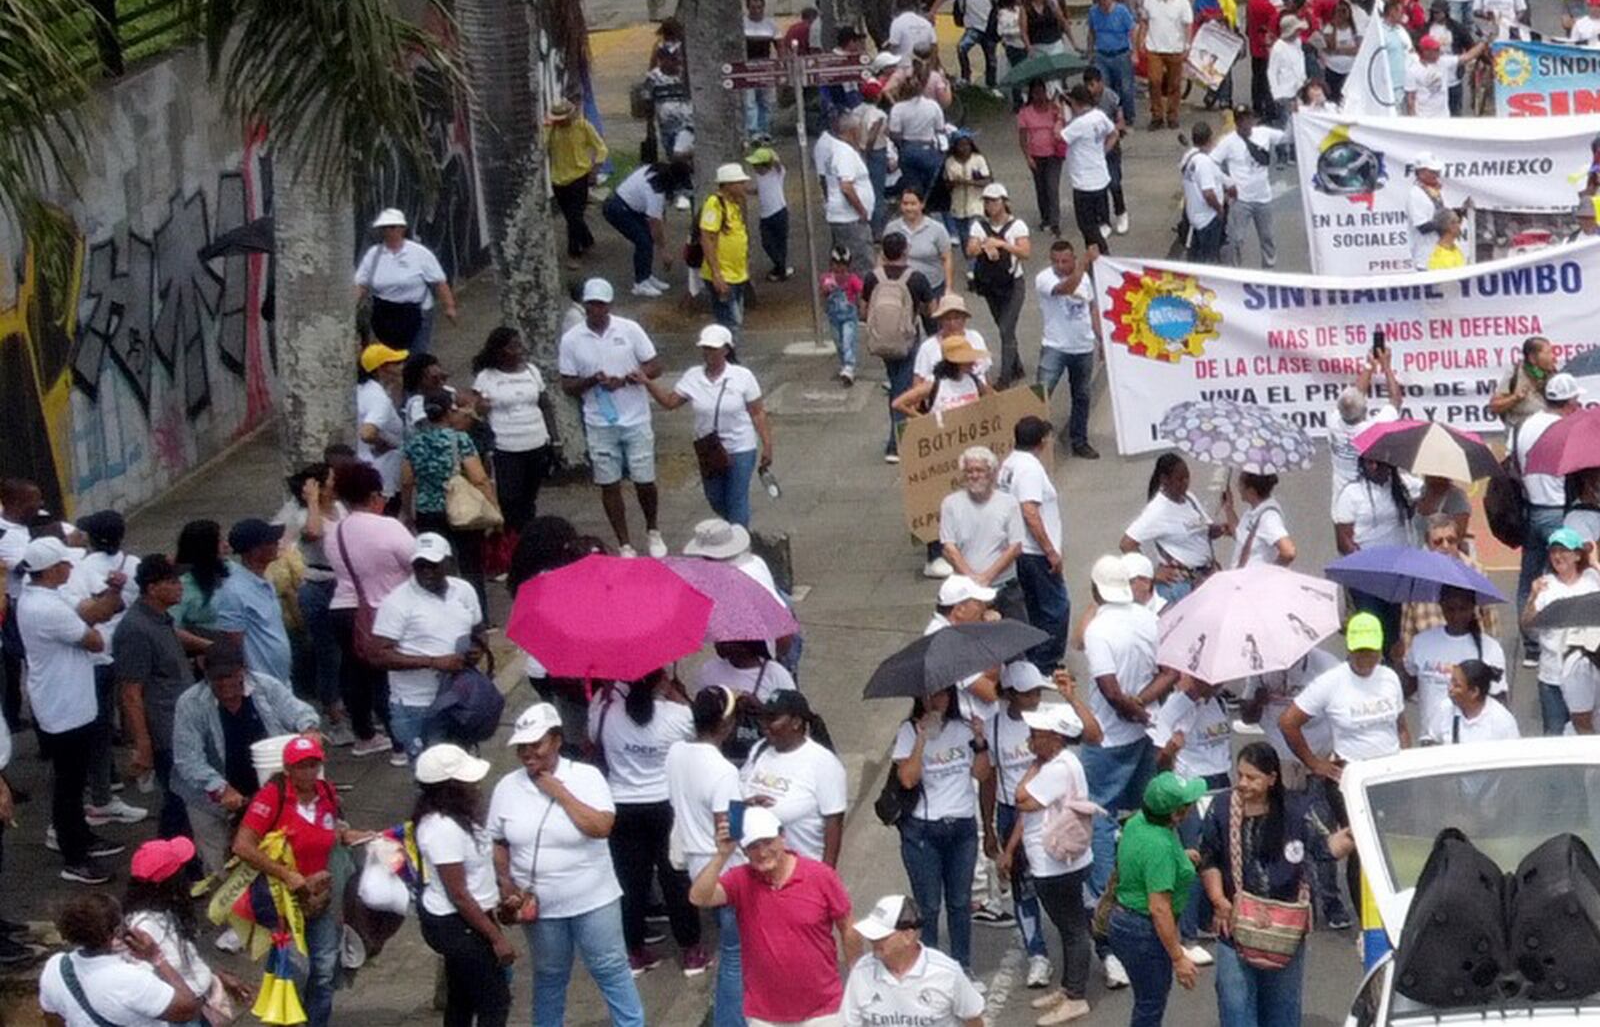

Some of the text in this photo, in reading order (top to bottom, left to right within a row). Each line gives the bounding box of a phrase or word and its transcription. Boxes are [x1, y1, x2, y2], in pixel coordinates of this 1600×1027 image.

[1311, 215, 1331, 229] EN
[1336, 214, 1357, 228] LA
[1332, 231, 1409, 249] SOCIALES
[1267, 328, 1309, 350] MAS
[1315, 326, 1339, 348] DE
[1345, 324, 1367, 346] 56
[1429, 320, 1456, 339] EN
[1461, 314, 1543, 337] DEFENSA
[1194, 359, 1218, 380] DE
[1224, 357, 1247, 377] LA
[1252, 355, 1313, 375] CLASE
[1403, 347, 1489, 373] POPULAR
[1493, 346, 1505, 366] Y
[1267, 385, 1297, 404] EL
[1433, 381, 1466, 398] DE
